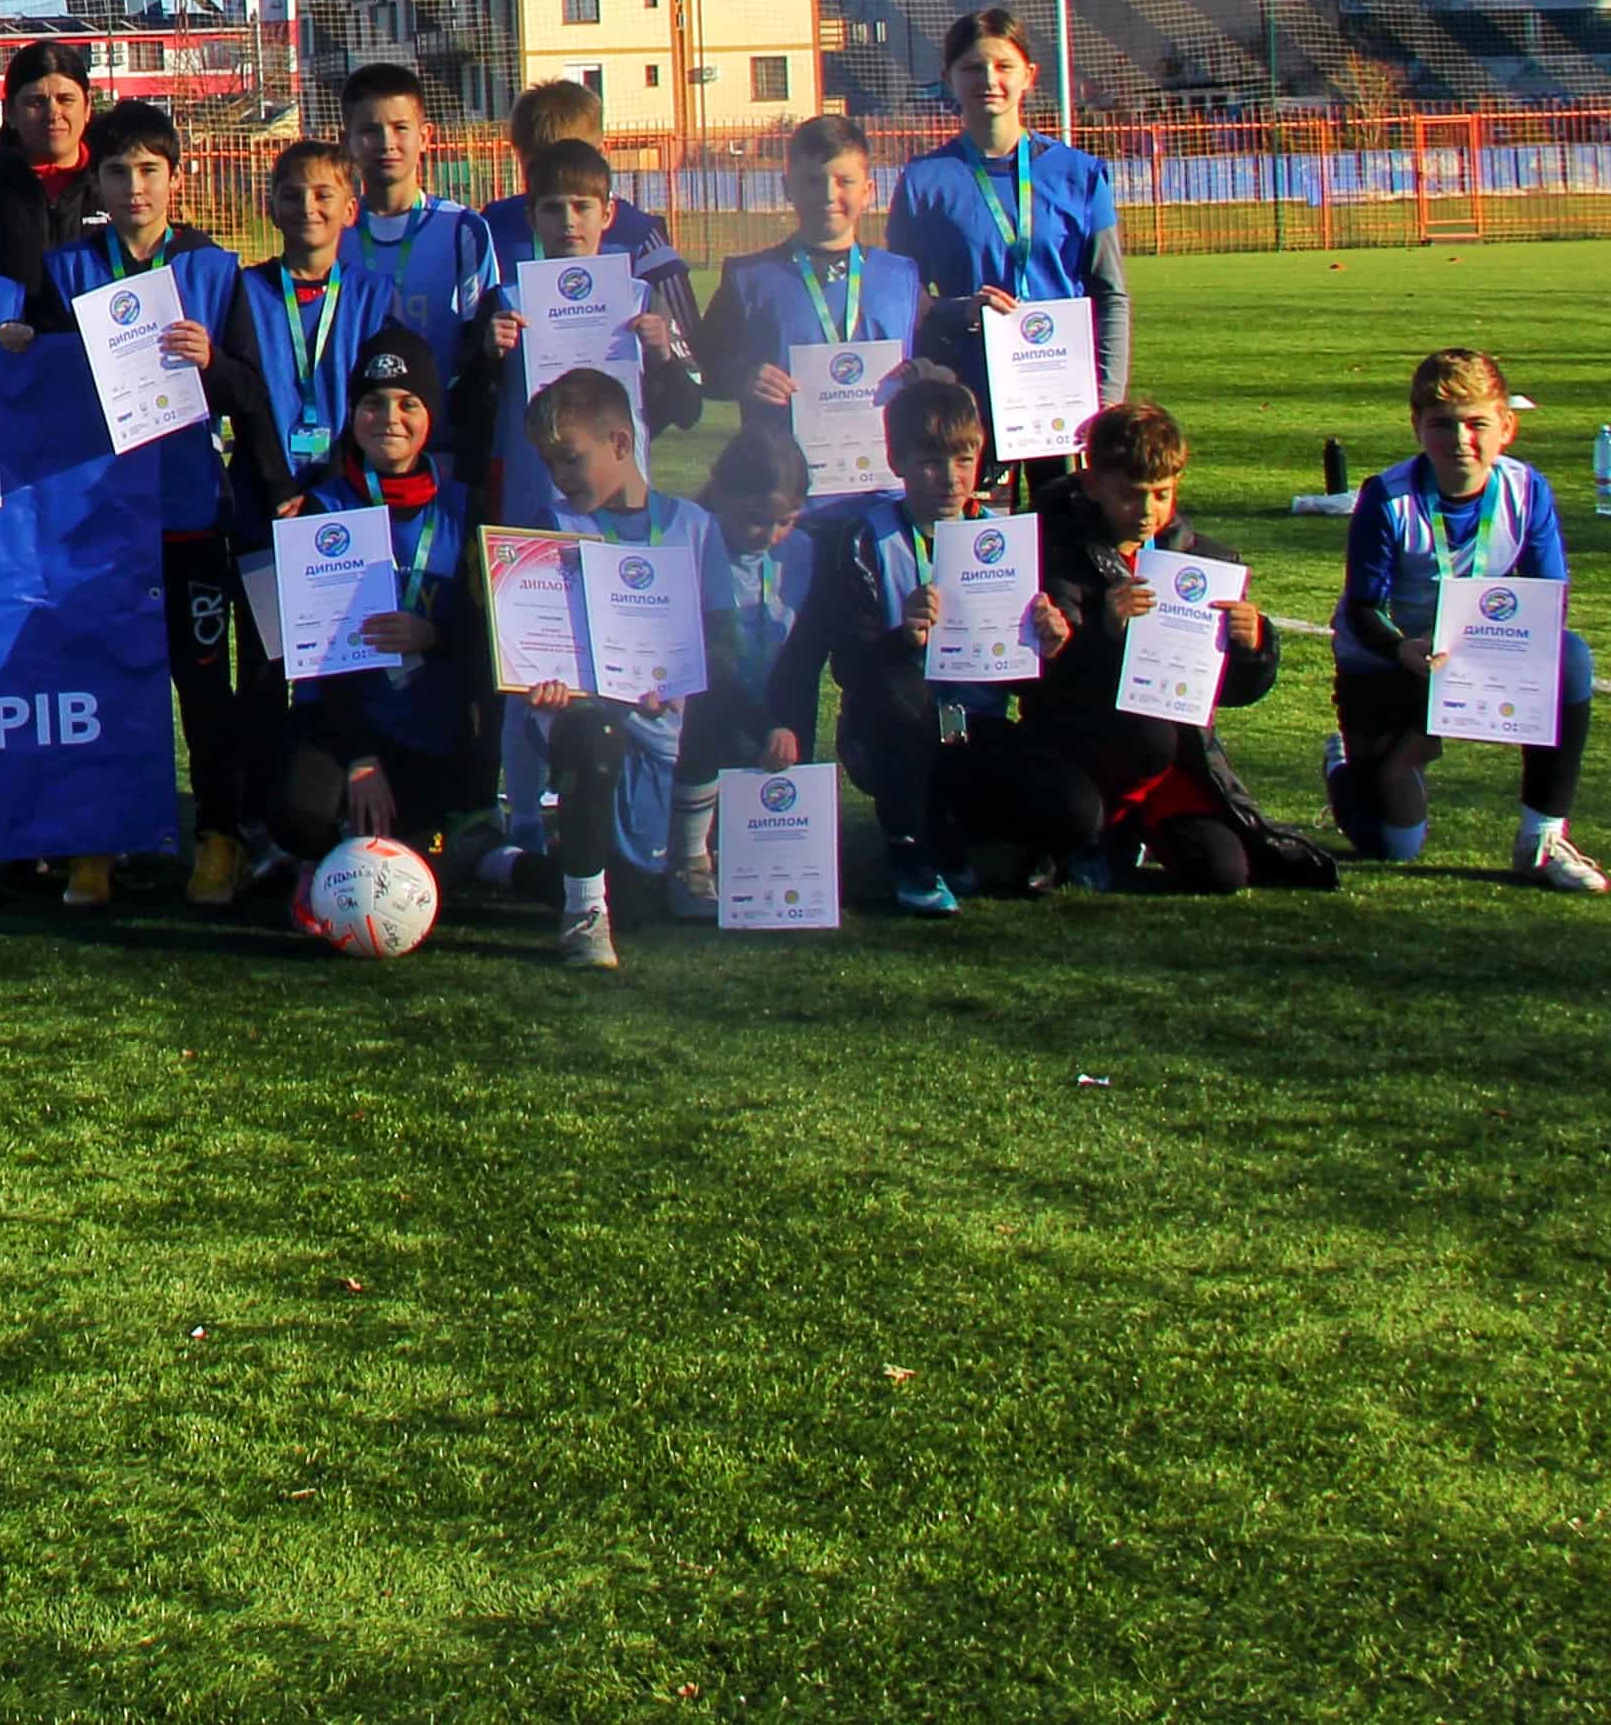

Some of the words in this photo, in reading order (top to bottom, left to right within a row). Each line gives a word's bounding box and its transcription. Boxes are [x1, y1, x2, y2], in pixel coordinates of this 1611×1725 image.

[548, 304, 607, 318] ДИПЛОМ
[108, 322, 159, 348] ДИПЛОМ
[1010, 347, 1068, 362] ДИПЛОМ
[305, 558, 365, 575] ДИПЛОМ
[960, 567, 1017, 582] ДИПЛОМ
[610, 592, 670, 605] ДИПЛОМ
[1158, 601, 1213, 622] ДИПЛОМ
[1463, 625, 1530, 638] ДИПЛОМ
[747, 817, 810, 829] ДИПЛОМ
